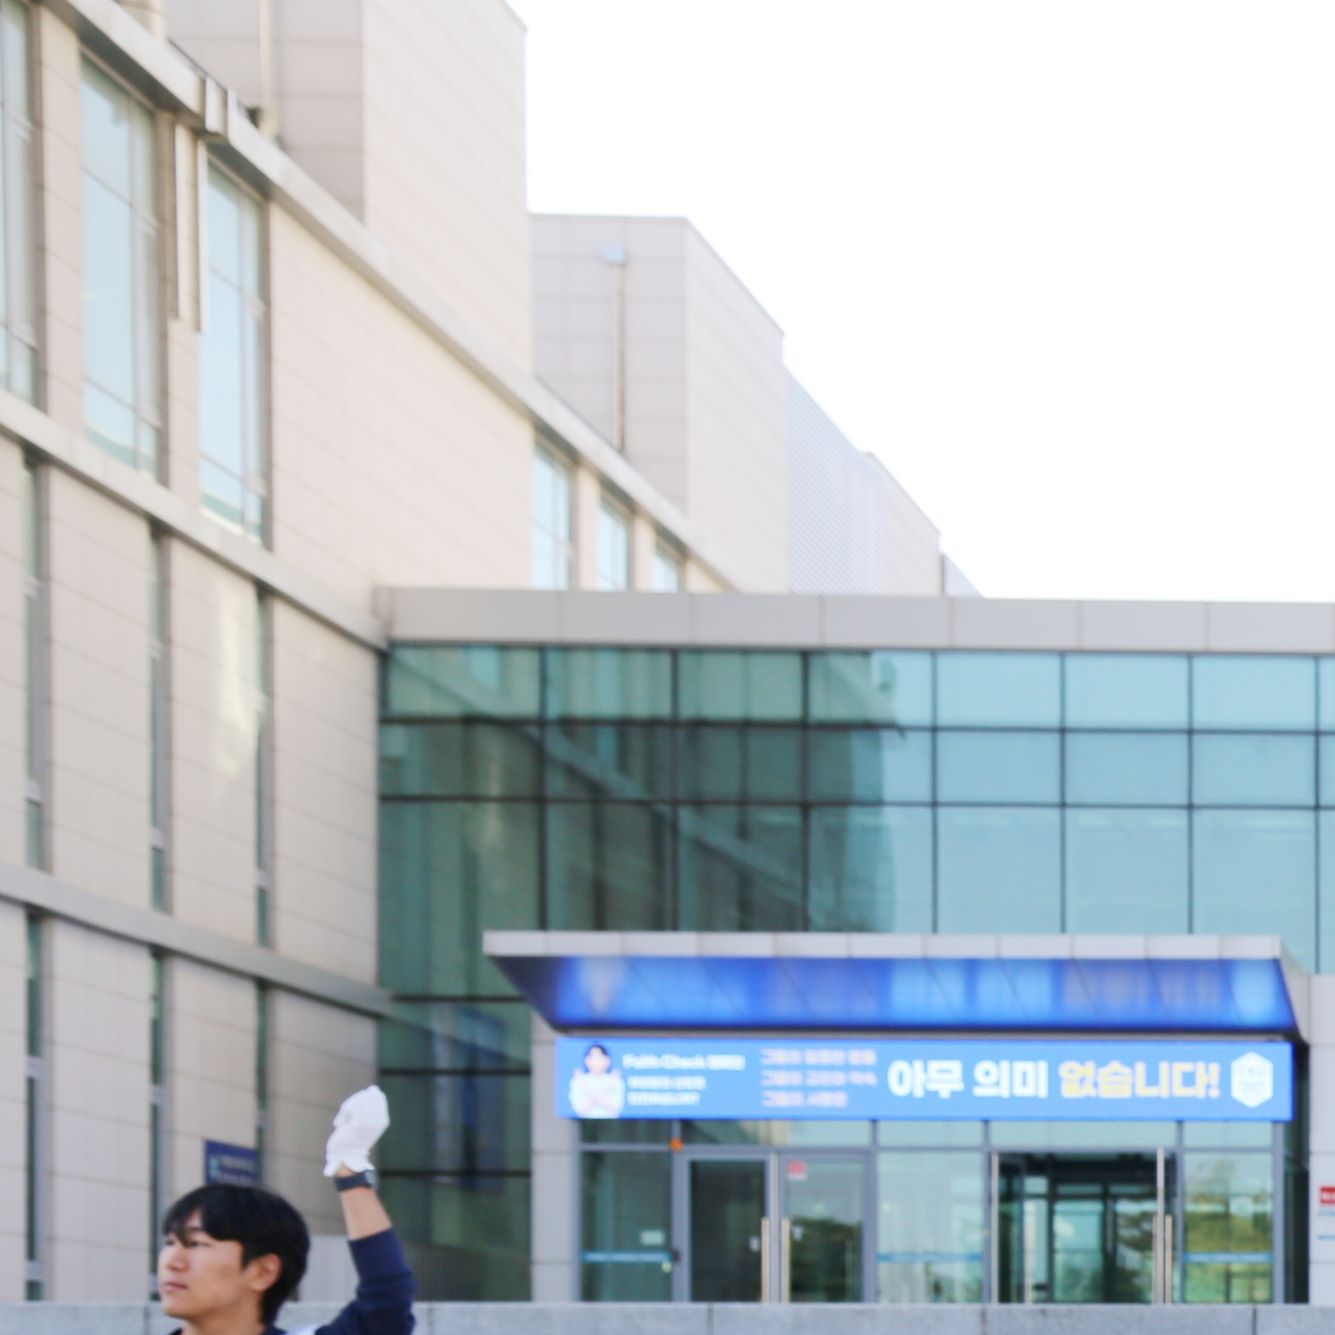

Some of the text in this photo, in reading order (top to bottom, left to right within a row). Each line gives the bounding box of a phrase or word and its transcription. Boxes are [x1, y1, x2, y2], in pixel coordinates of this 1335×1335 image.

[887, 1059, 964, 1098] 아무
[972, 1059, 1049, 1098] 의미
[1058, 1060, 1221, 1099] 없습니다!
